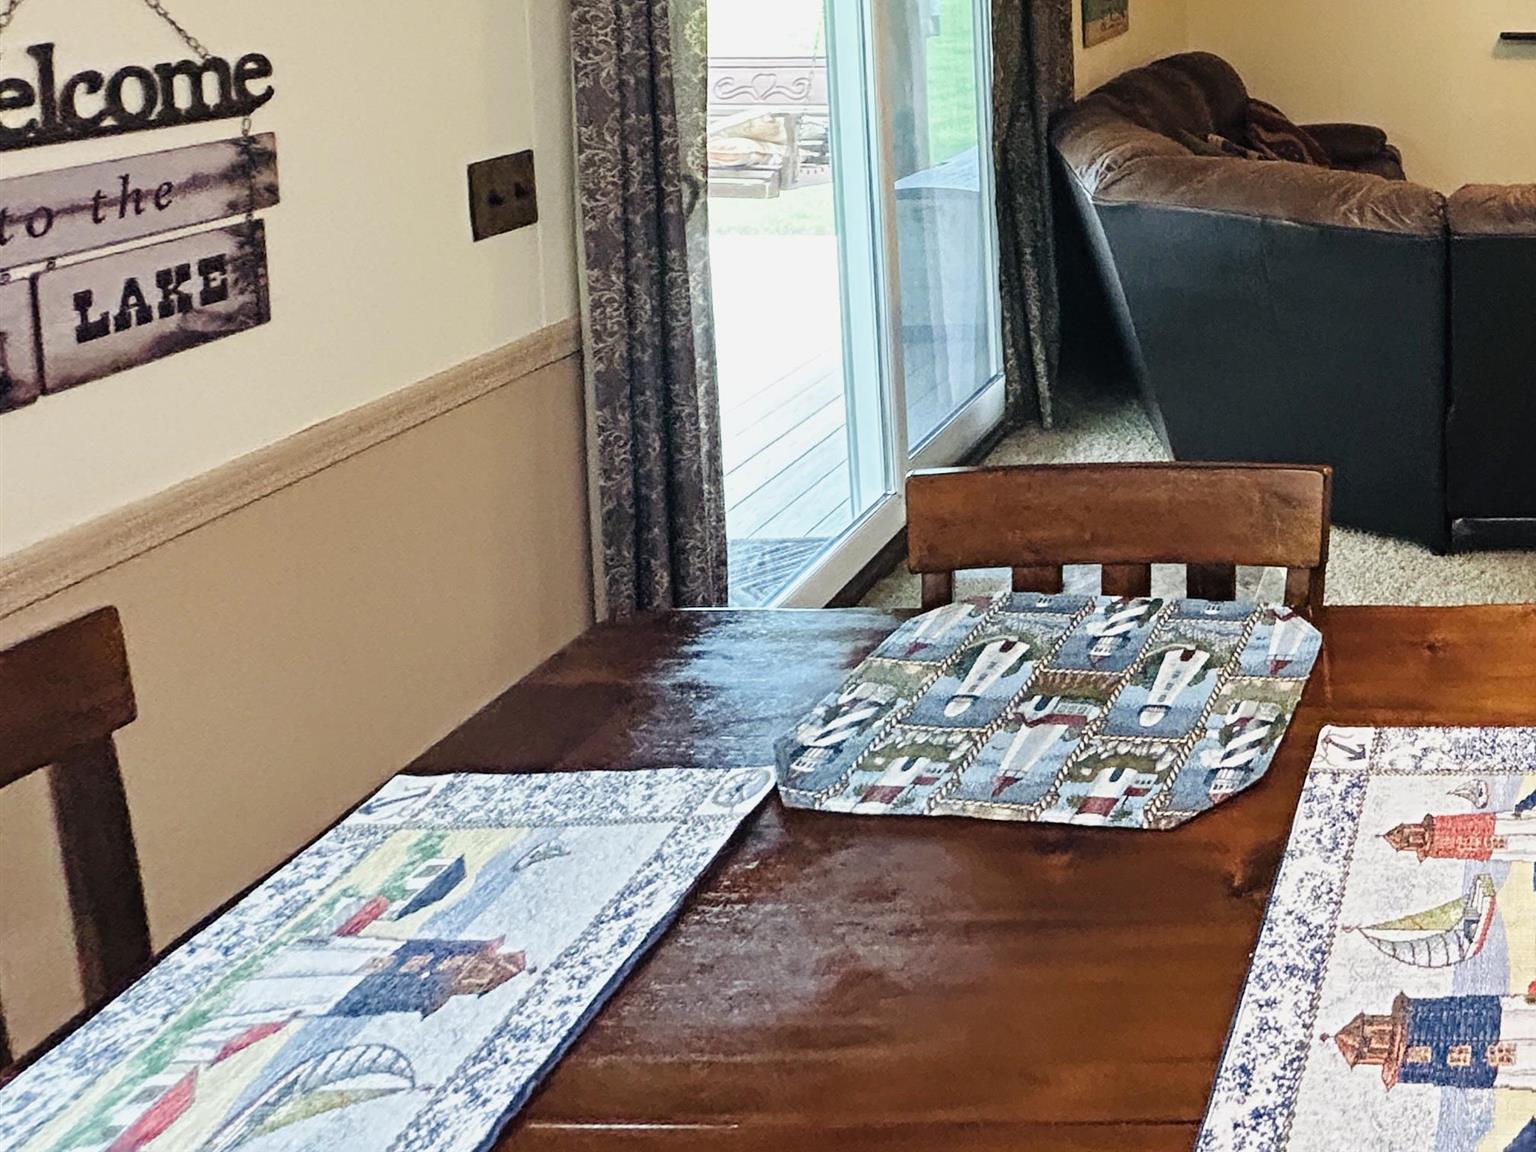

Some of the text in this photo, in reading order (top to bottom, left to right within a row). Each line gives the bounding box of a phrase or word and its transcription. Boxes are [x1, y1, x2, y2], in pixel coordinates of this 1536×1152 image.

[0, 43, 274, 151] elcome
[92, 173, 175, 225] the
[72, 253, 228, 345] LAKE
